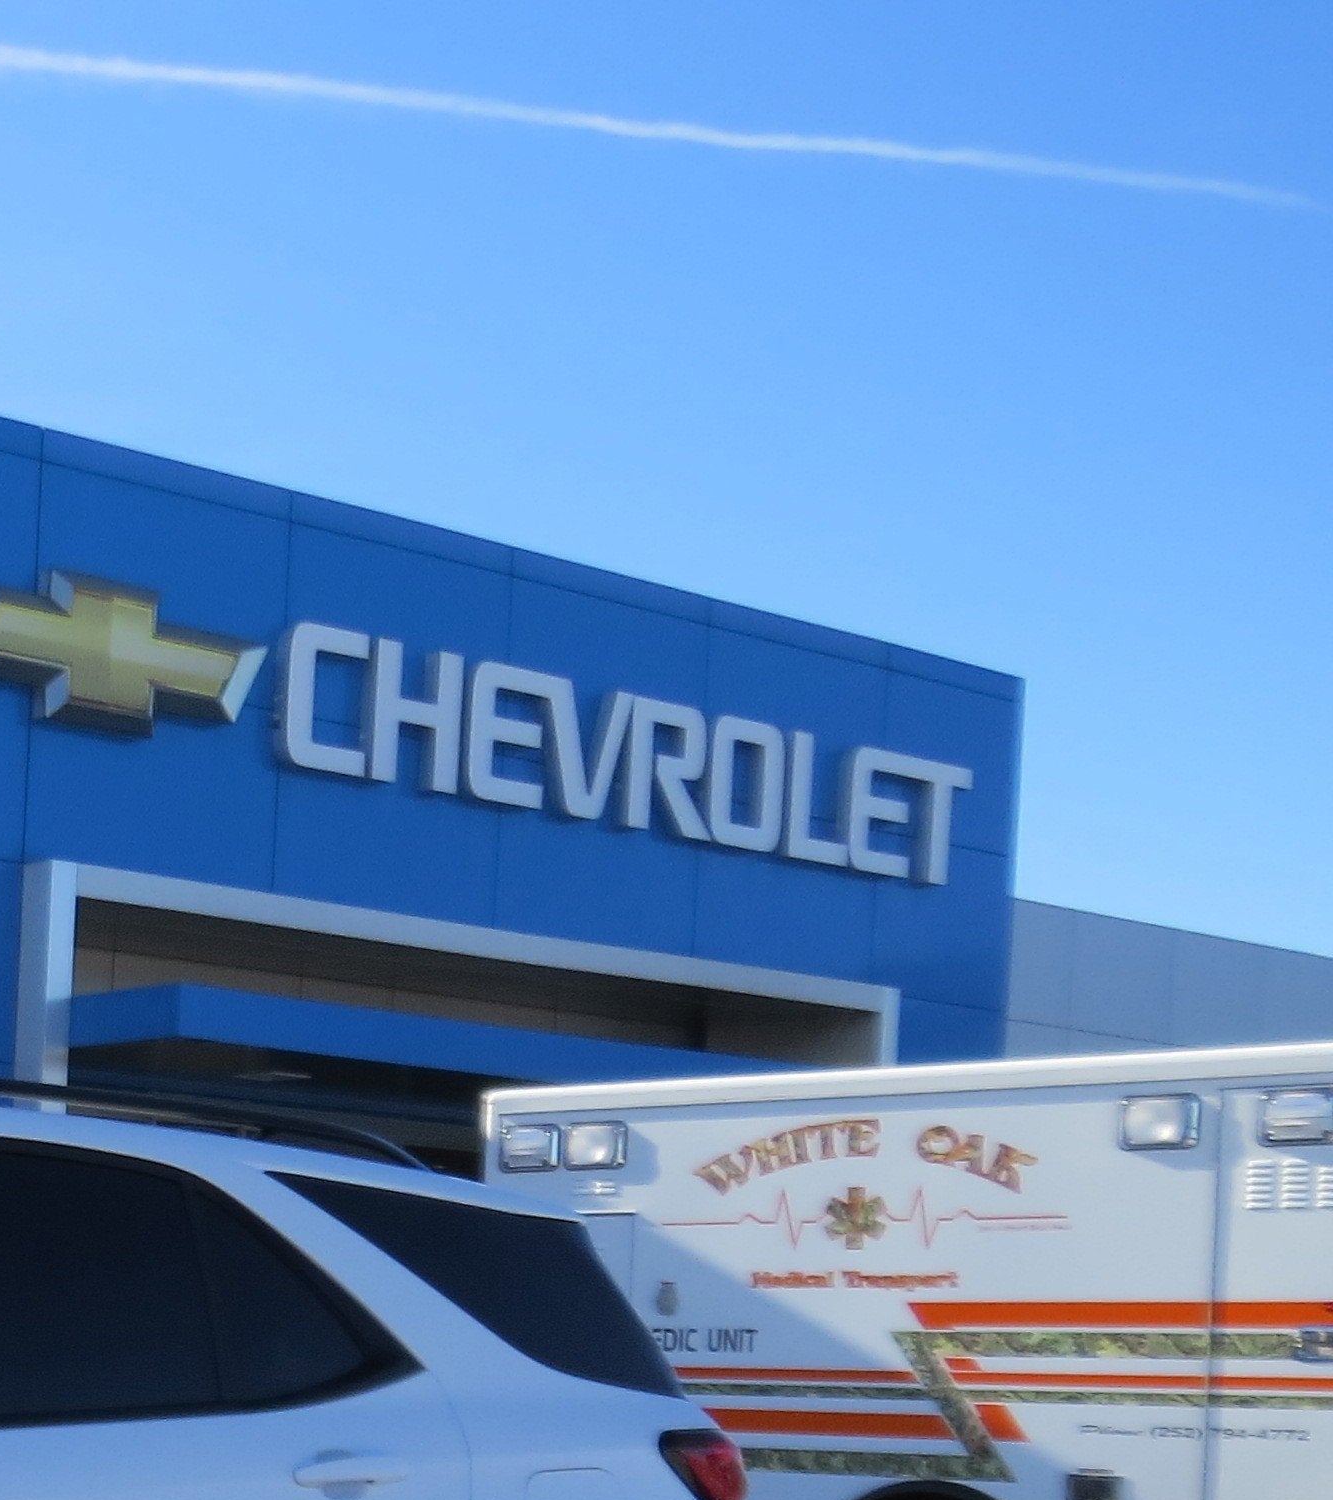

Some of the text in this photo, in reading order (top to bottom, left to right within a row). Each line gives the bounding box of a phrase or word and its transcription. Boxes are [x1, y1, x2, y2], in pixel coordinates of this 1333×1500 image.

[281, 621, 974, 887] CHEVROLET
[694, 1118, 1039, 1196] WHITE OAK
[651, 1327, 760, 1353] EDIC UNIT
